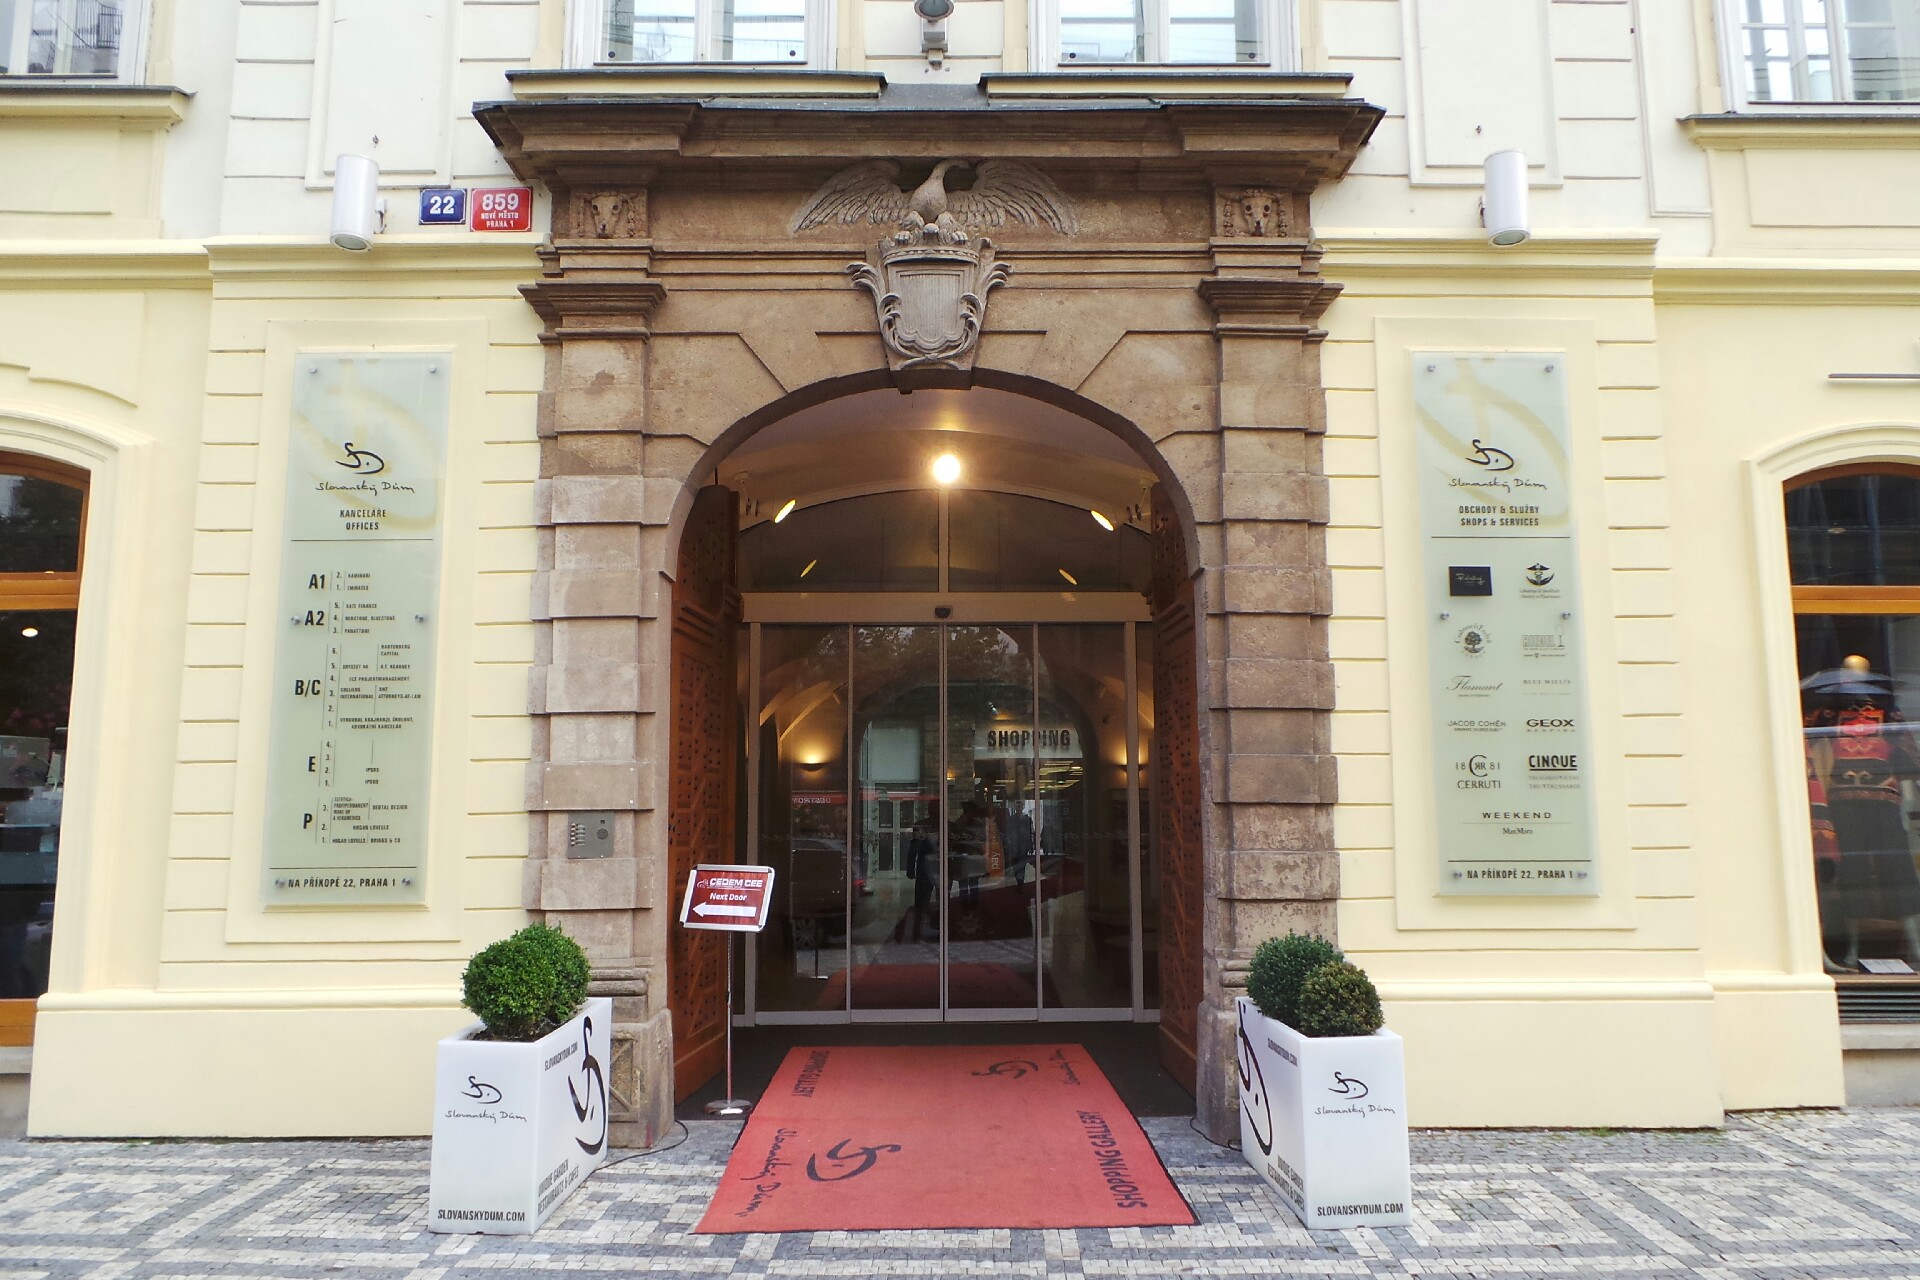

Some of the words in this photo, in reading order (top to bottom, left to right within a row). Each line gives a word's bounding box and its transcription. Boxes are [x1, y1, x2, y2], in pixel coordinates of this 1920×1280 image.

[430, 196, 455, 214] 22
[482, 193, 519, 211] 859
[498, 211, 519, 219] MĚSTO
[1458, 506, 1497, 514] OBCHODY
[1509, 504, 1540, 513] SLUŽBY
[346, 521, 379, 531] OFFICES
[1460, 518, 1487, 526] SHOPS
[1491, 518, 1496, 526] &
[1500, 518, 1539, 526] SERVICES
[308, 574, 325, 590] A1
[304, 610, 325, 626] A2
[294, 679, 321, 698] B/C
[1446, 675, 1504, 691] Flamant
[1526, 719, 1575, 728] GEOX
[308, 755, 316, 772] E
[1529, 755, 1578, 769] CINQUE
[1457, 779, 1502, 789] CERRUTI
[303, 813, 313, 829] P
[1467, 870, 1478, 879] NA
[1521, 870, 1534, 880] 22,
[1537, 870, 1565, 879] PRAHA
[1569, 870, 1573, 879] 1
[288, 879, 300, 888] NA
[343, 878, 356, 888] 22,
[359, 878, 388, 887] PRAHA
[392, 878, 396, 887] 1
[744, 879, 763, 888] CEE
[709, 892, 728, 900] Next
[728, 893, 748, 901] Door
[1076, 1110, 1117, 1147] GALLERY
[1094, 1150, 1148, 1208] SHOPPING
[437, 1209, 526, 1222] SLOVANSKYDUM.COM
[1317, 1203, 1404, 1217] SLOVANSKYDUM.COM
